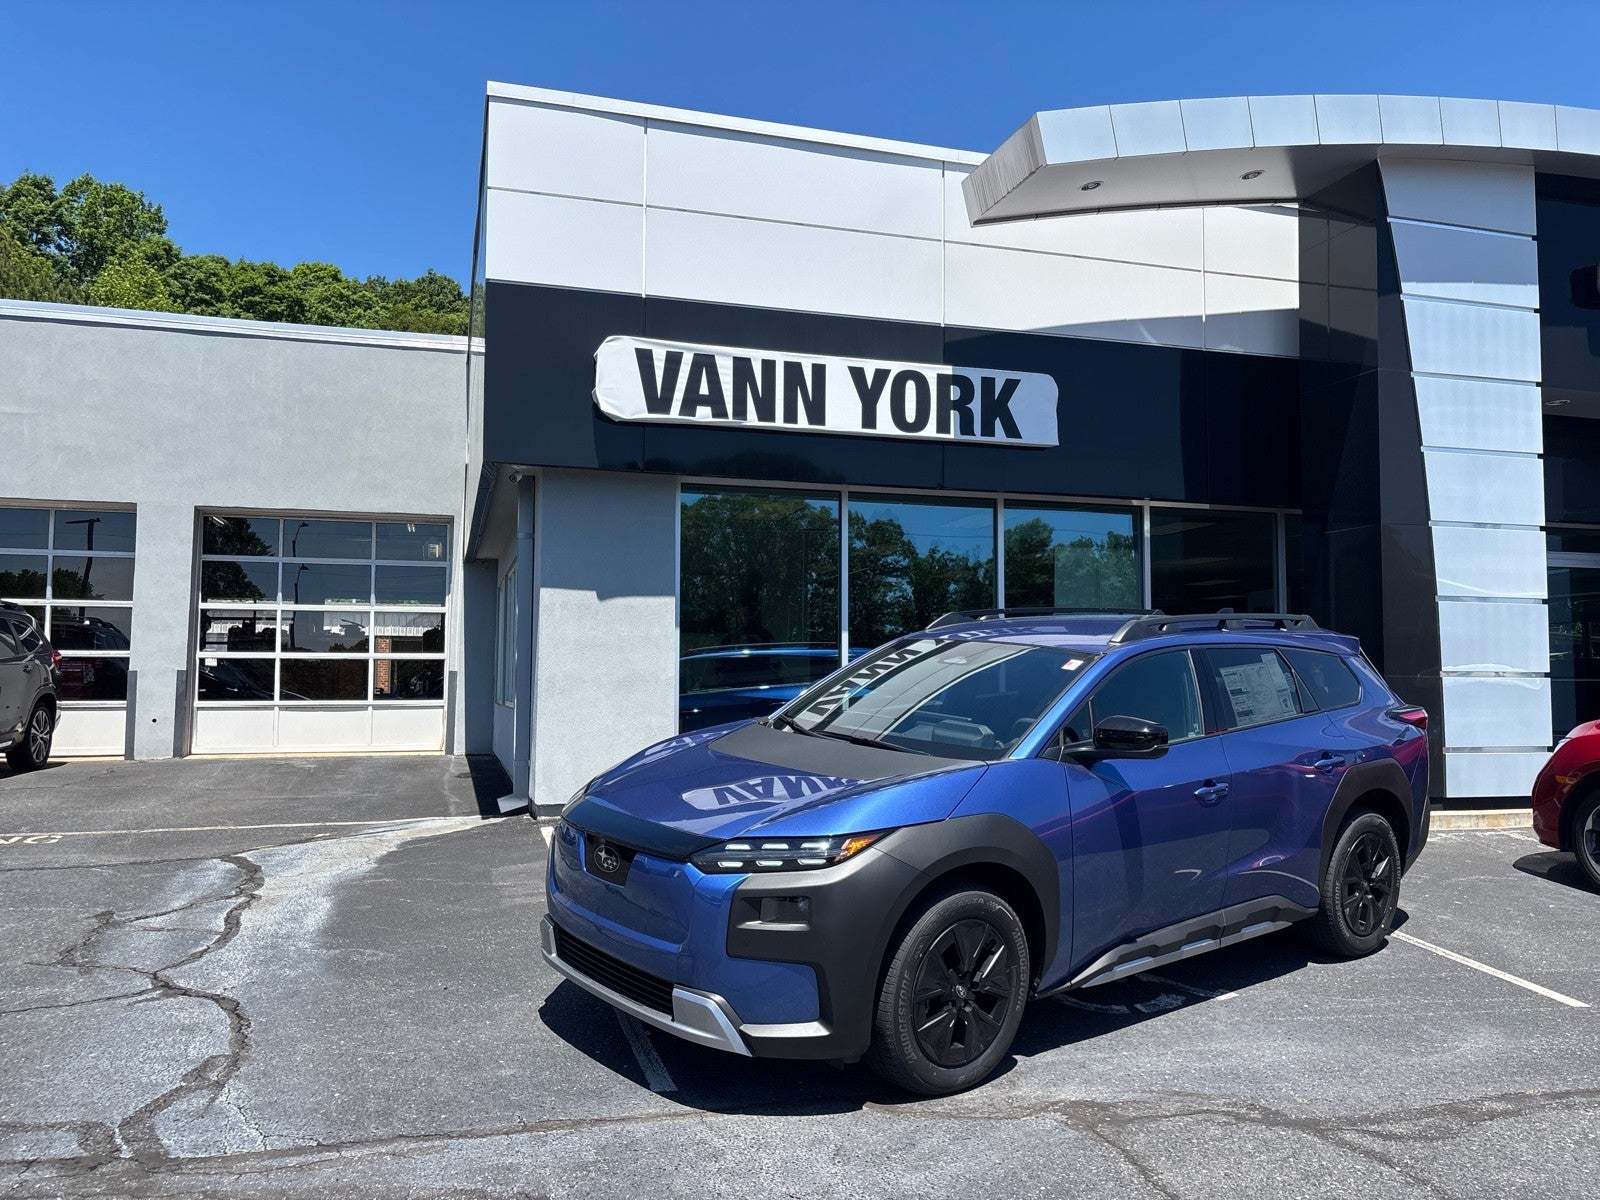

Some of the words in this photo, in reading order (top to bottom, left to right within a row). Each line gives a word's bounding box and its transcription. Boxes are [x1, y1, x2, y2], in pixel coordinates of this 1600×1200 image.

[635, 347, 826, 427] VANN
[847, 365, 1023, 439] YORK
[898, 970, 917, 1064] BRIDGESTONE
